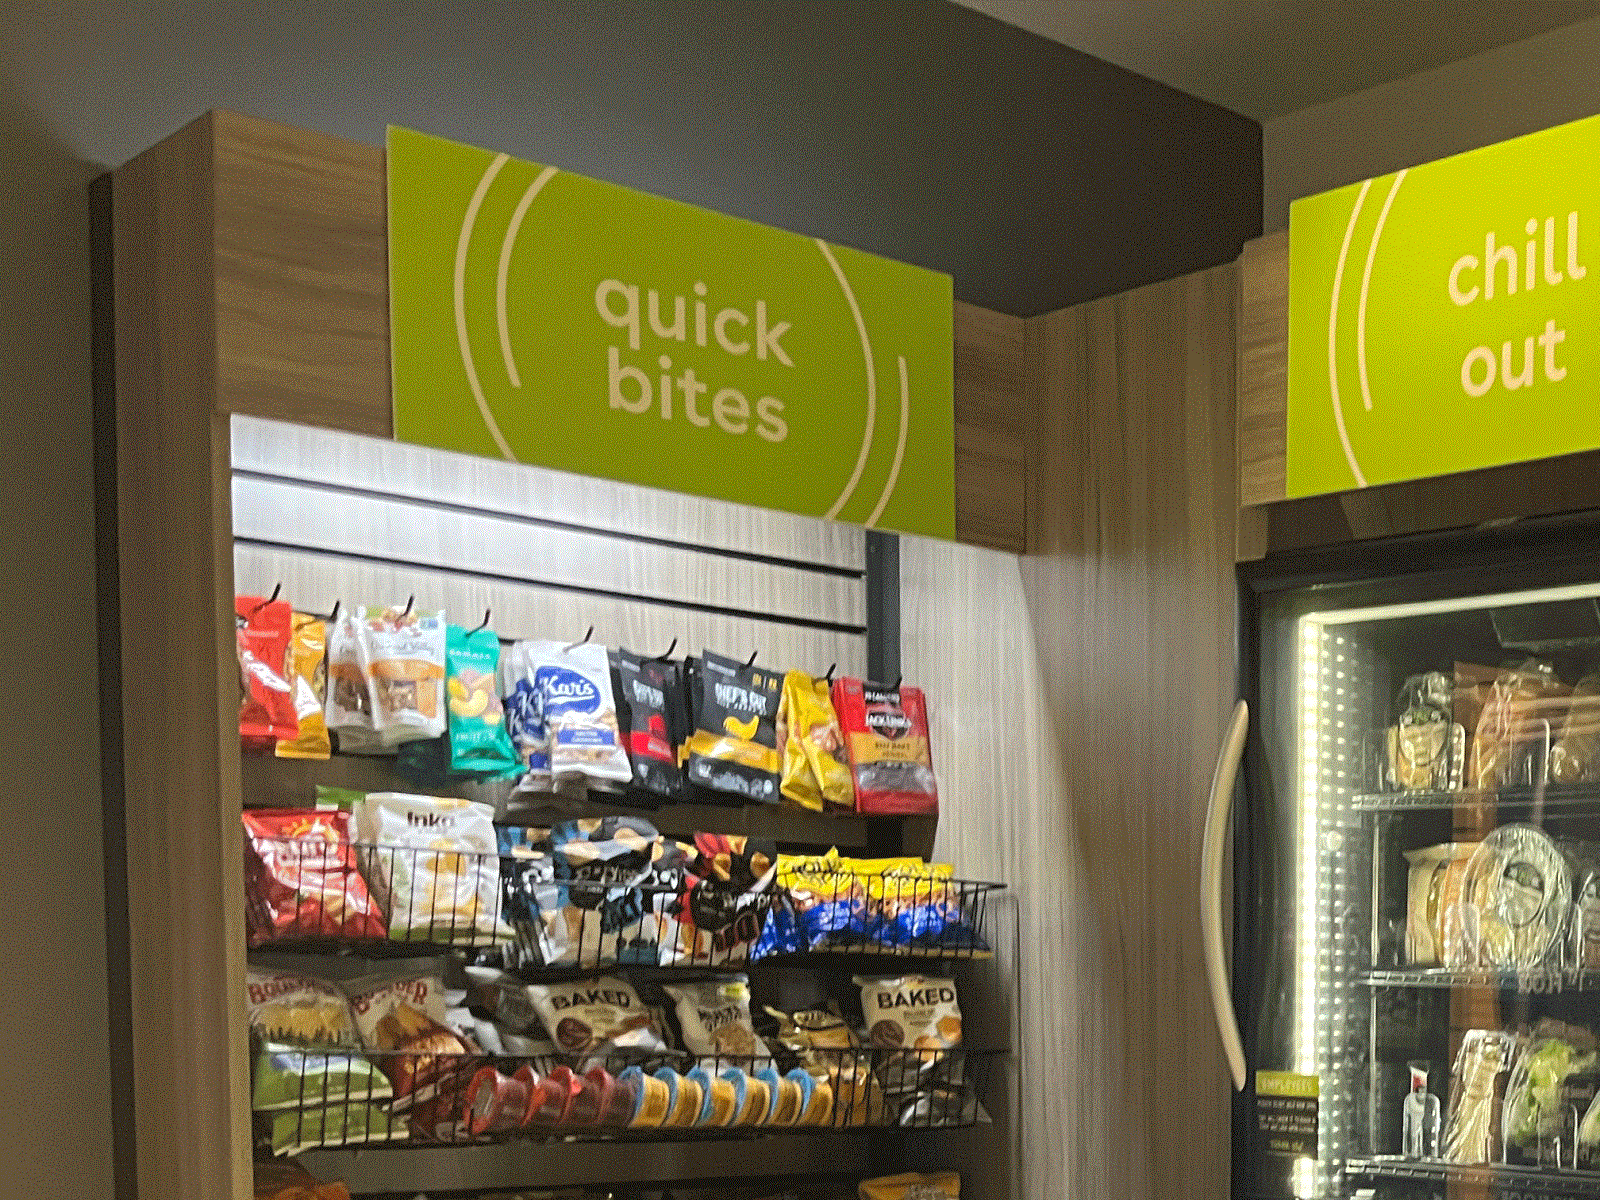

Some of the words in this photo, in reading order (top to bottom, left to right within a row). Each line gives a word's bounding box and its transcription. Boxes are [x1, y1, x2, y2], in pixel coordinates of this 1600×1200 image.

[1447, 211, 1587, 307] chill
[594, 278, 795, 367] quick
[1460, 319, 1568, 398] out
[607, 346, 789, 443] bites
[552, 988, 630, 1009] BAKED
[876, 987, 955, 1010] BAKED
